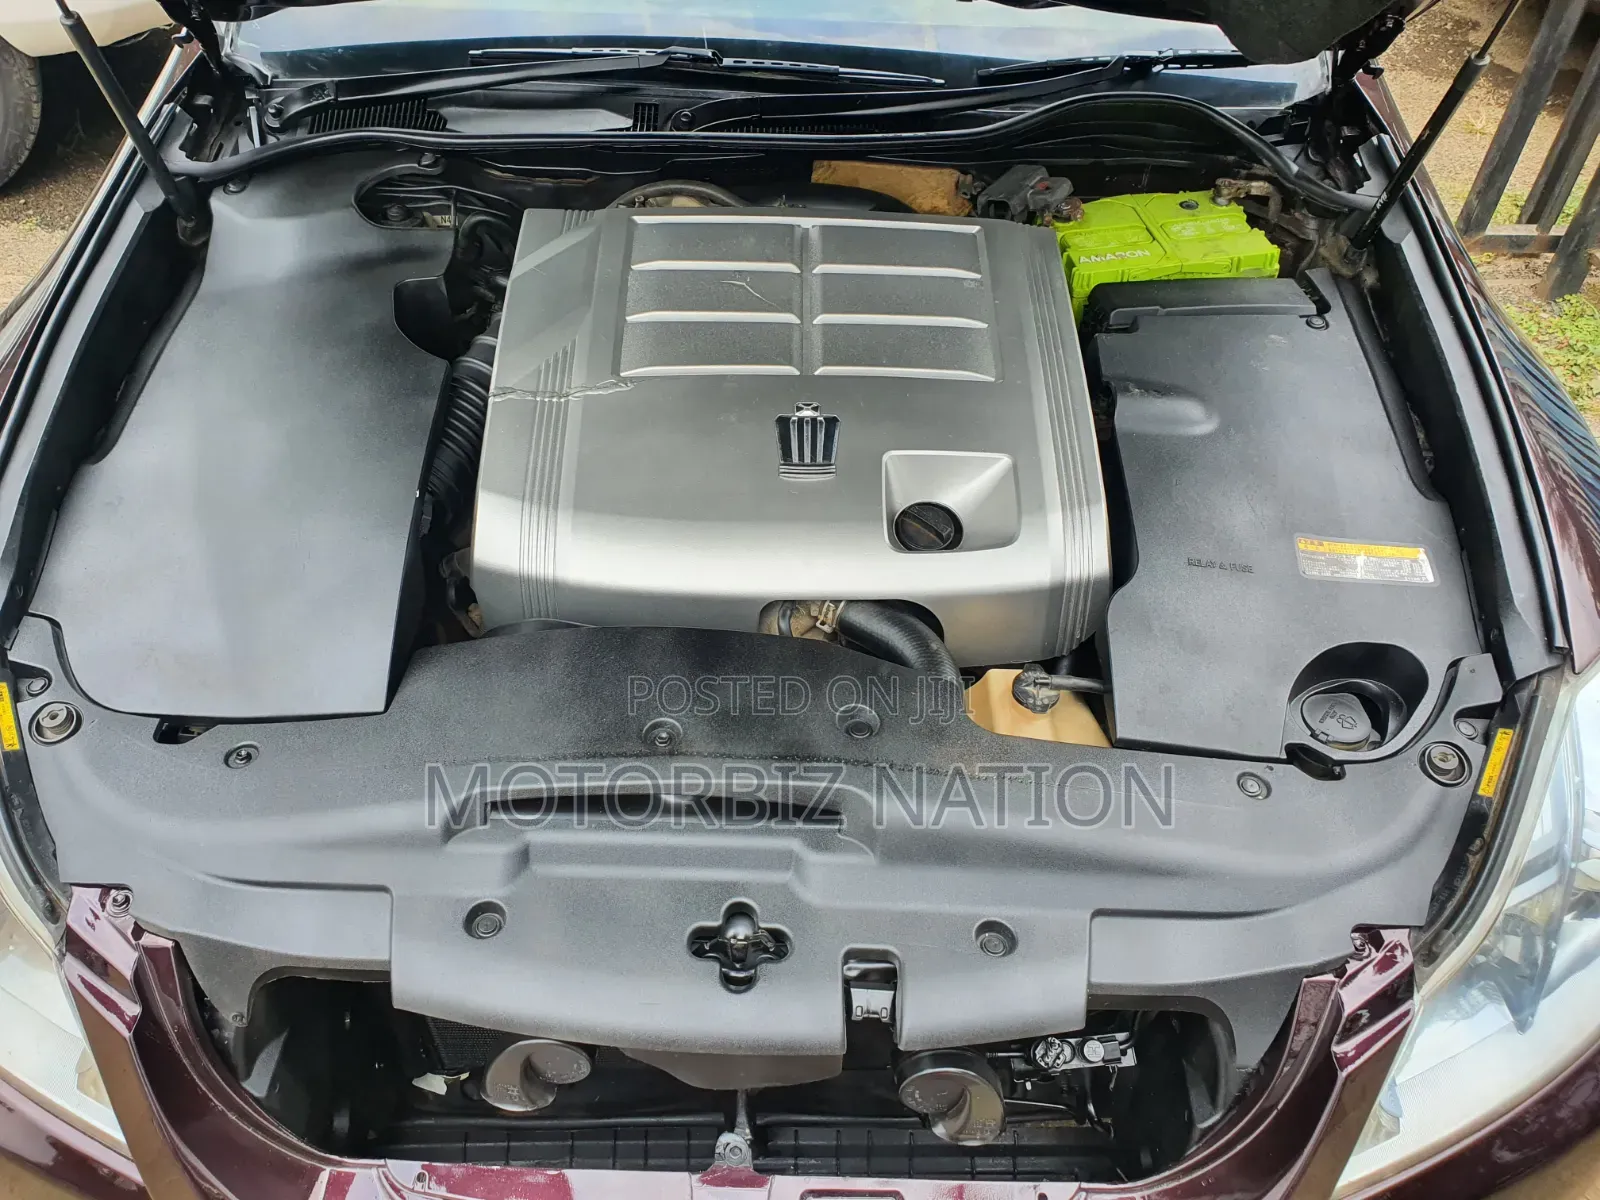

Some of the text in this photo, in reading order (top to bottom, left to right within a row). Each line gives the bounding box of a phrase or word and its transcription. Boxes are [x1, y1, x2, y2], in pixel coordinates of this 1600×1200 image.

[1079, 248, 1151, 264] AMARON
[1187, 557, 1217, 569] RELAY
[1229, 562, 1254, 574] FUSE
